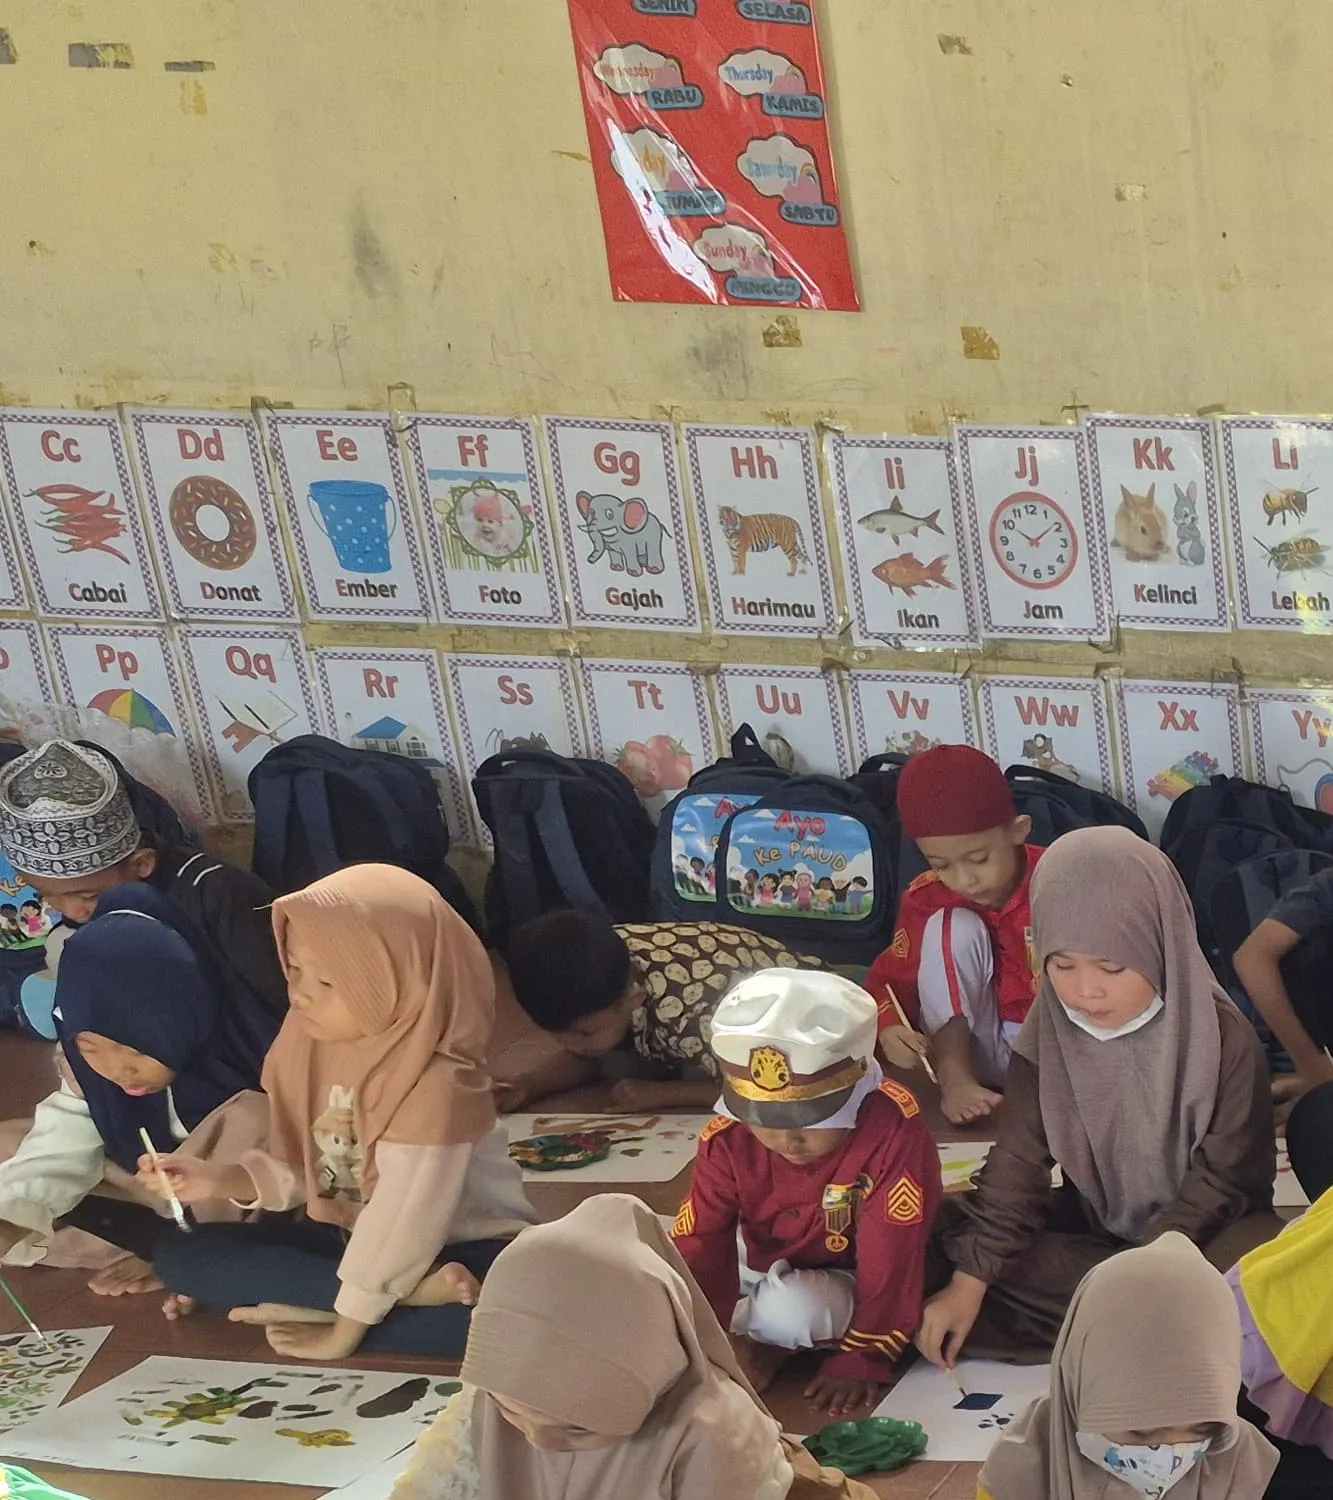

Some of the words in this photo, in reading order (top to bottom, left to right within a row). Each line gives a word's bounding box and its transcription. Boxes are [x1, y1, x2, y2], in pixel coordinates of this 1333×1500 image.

[742, 3, 806, 21] SELASA
[724, 65, 774, 84] Thursday
[651, 88, 697, 104] RABU
[766, 95, 821, 113] KAMIS
[783, 205, 836, 221] SABTU
[702, 241, 748, 261] Sunday
[40, 430, 82, 463] Cc
[178, 429, 225, 462] Dd
[317, 430, 359, 463] Ee
[456, 435, 490, 468] Ff
[1131, 437, 1175, 472] Kk
[593, 442, 642, 486] Gg
[731, 446, 778, 480] Hh
[1014, 446, 1040, 486] Jj
[1012, 508, 1023, 519] 11
[1024, 504, 1037, 516] 12
[1042, 510, 1049, 520] 1
[1001, 520, 1016, 531] 10
[1054, 522, 1063, 533] 2
[1000, 535, 1009, 546] 9
[1060, 538, 1069, 549] 3
[1005, 551, 1015, 562] 8
[1056, 554, 1065, 565] 4
[1018, 564, 1027, 575] 7
[1033, 568, 1042, 579] 6
[1047, 565, 1056, 576] 5
[68, 581, 128, 604] Cabai
[199, 581, 262, 603] Donat
[335, 578, 398, 600] Ember
[478, 585, 523, 607] Foto
[605, 587, 664, 613] Gajah
[1134, 583, 1198, 606] Kelinci
[732, 596, 816, 619] Harimau
[897, 609, 940, 629] Ikan
[1023, 600, 1064, 620] Jam
[96, 645, 139, 679] Pp
[224, 645, 277, 684] Qq
[363, 668, 399, 700] Rr
[498, 675, 534, 707] Ss
[627, 681, 664, 712] Tt
[755, 684, 802, 715] Uu
[887, 689, 929, 721] Vv
[1014, 695, 1080, 728] Ww
[1158, 700, 1199, 732] Xx
[1291, 709, 1331, 748] Yy
[775, 810, 826, 841] Ayo
[789, 839, 848, 872] PAUD
